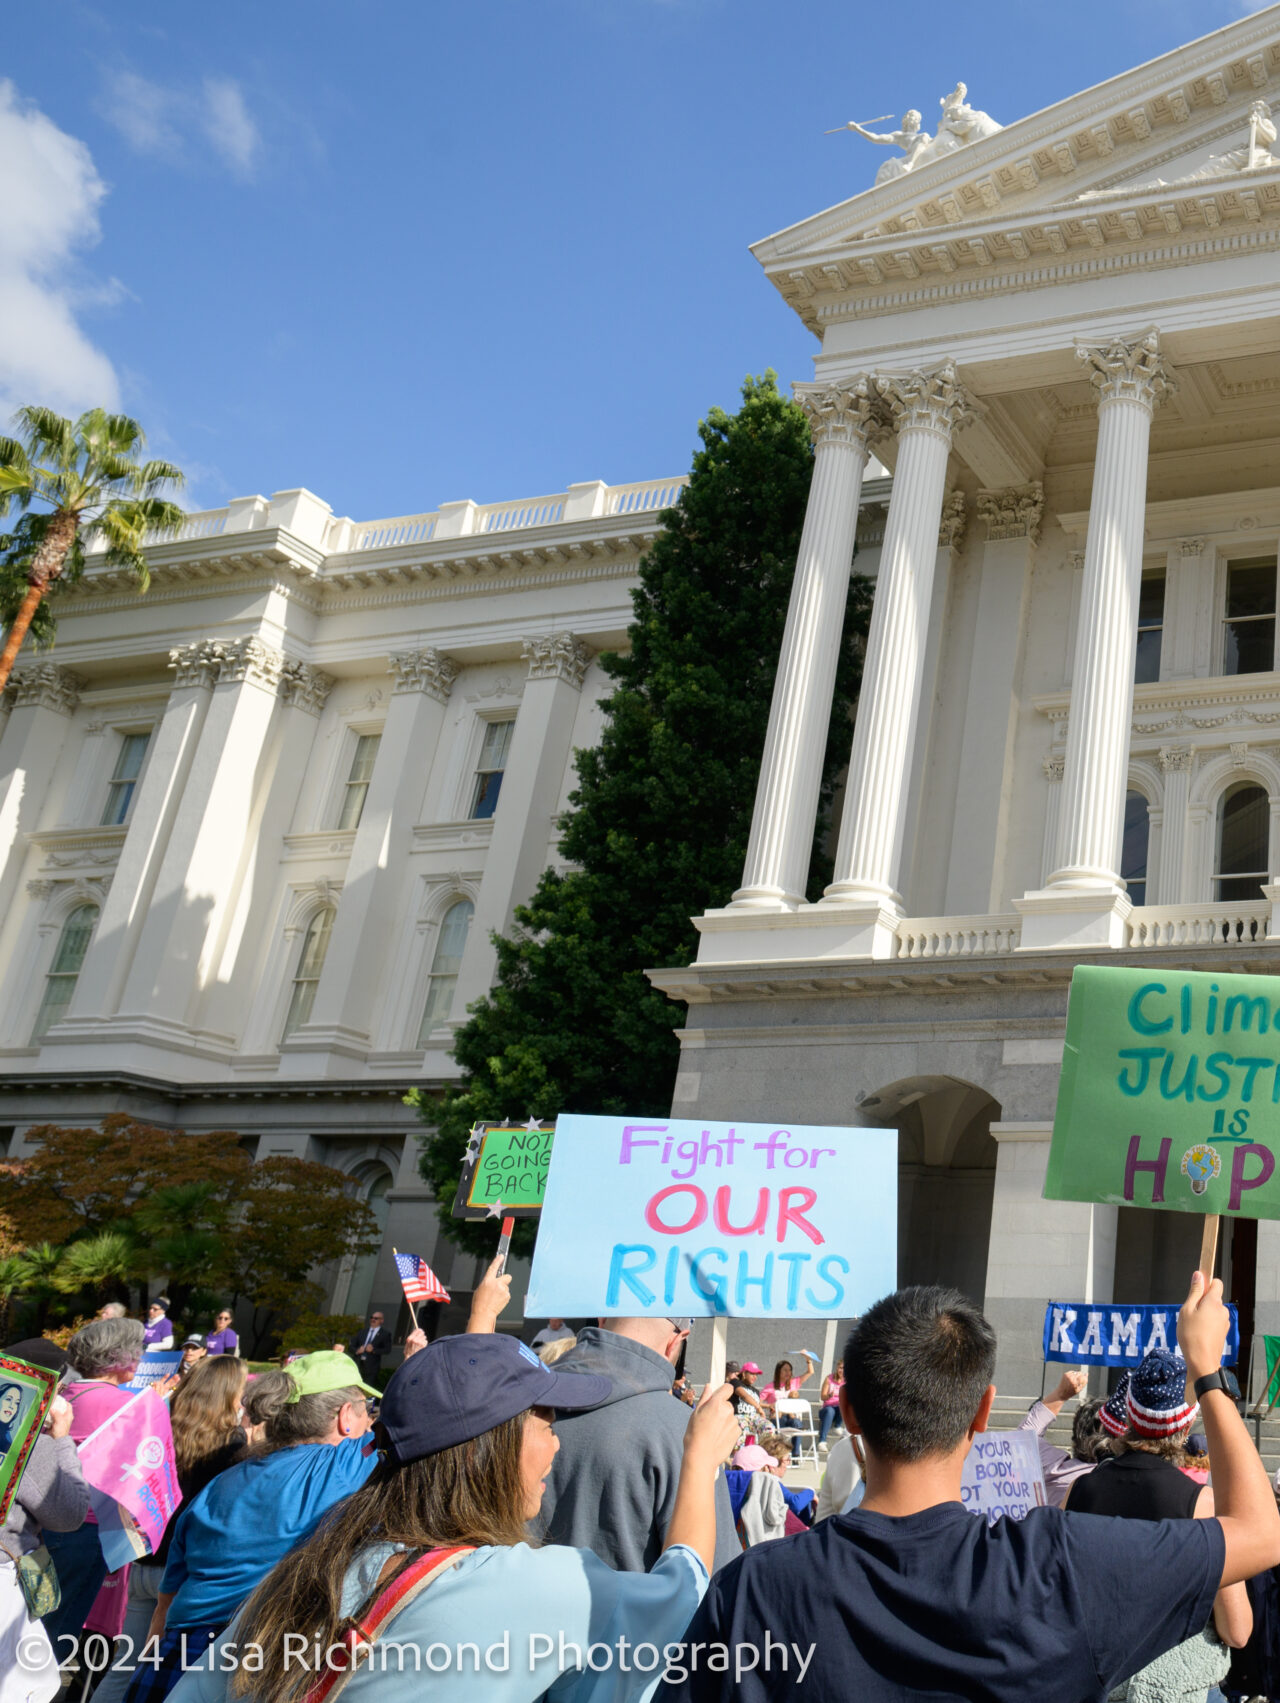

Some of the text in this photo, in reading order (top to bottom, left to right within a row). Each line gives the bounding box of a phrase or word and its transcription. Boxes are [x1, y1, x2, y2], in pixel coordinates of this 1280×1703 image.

[1213, 1109, 1250, 1137] IS
[508, 1132, 554, 1151] NOT
[619, 1126, 837, 1179] Fight for
[483, 1150, 552, 1171] GOING
[485, 1172, 548, 1197] BACK
[645, 1183, 825, 1245] OUR
[605, 1243, 850, 1312] RIGHTS
[1050, 1308, 1231, 1357] KAMA
[975, 1441, 1011, 1459] YOUR
[960, 1481, 1030, 1502] OT YOUR
